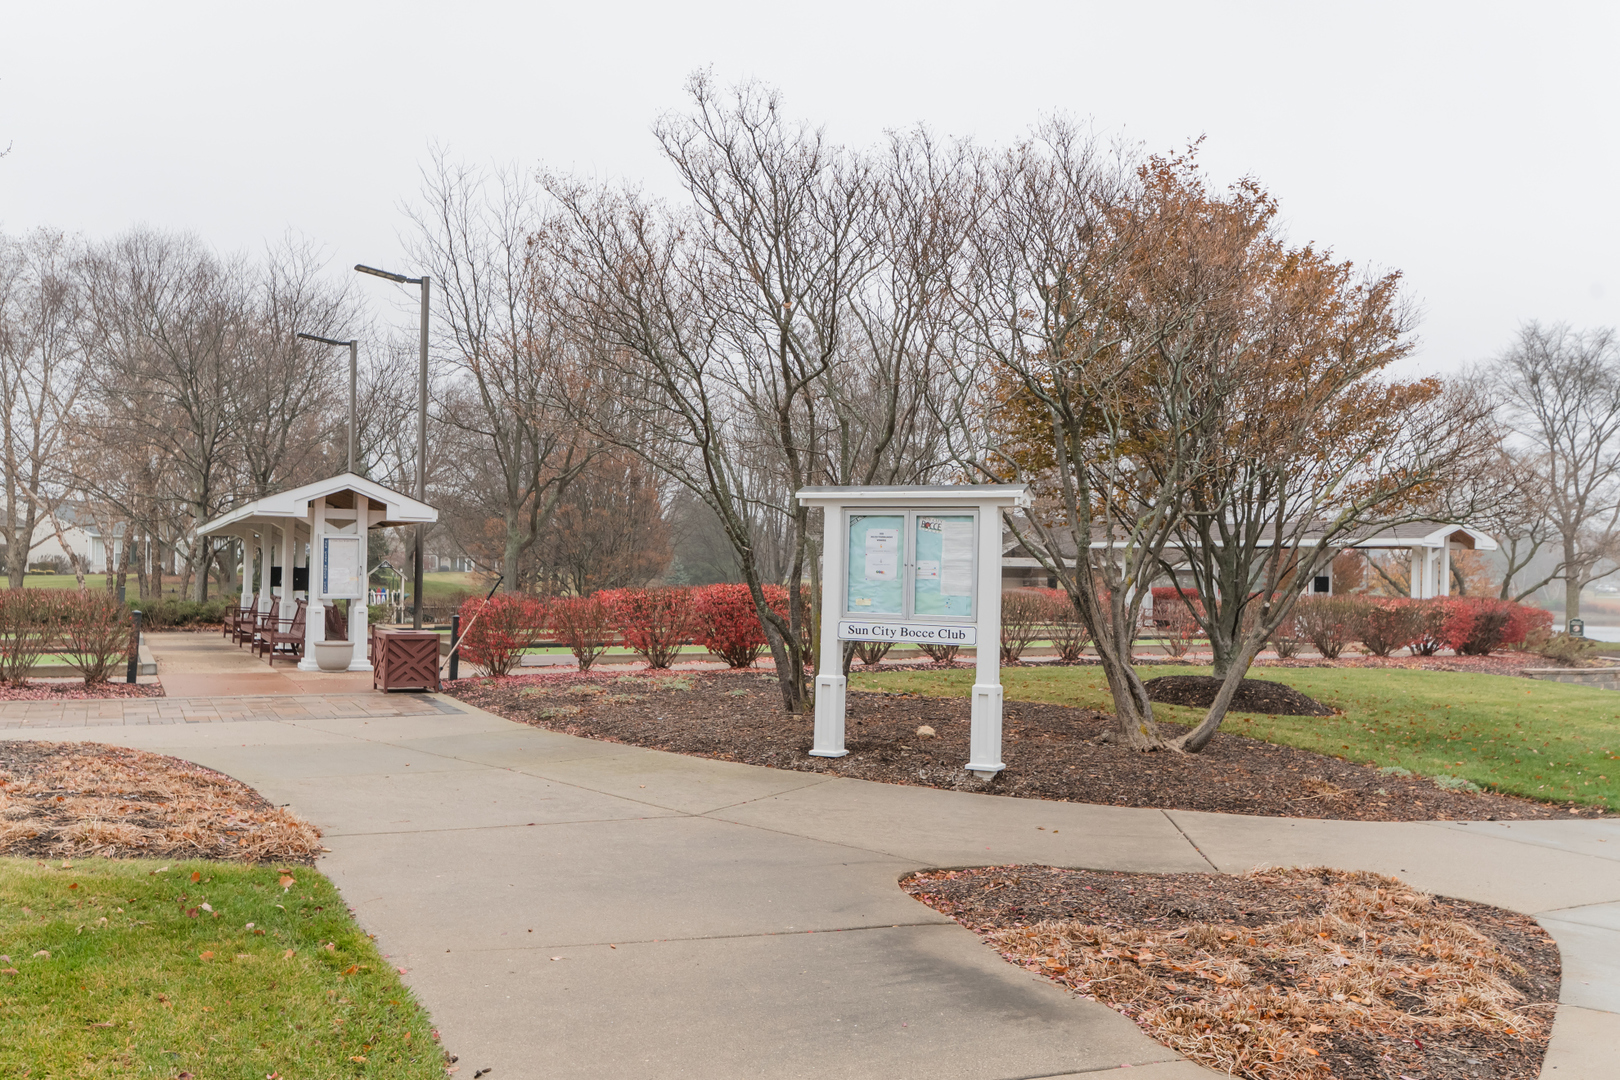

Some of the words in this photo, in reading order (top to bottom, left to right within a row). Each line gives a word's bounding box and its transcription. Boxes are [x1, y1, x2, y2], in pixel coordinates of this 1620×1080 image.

[848, 624, 868, 635] Sun
[872, 625, 897, 639] City
[900, 626, 934, 638] Bocce
[938, 628, 966, 640] Club
